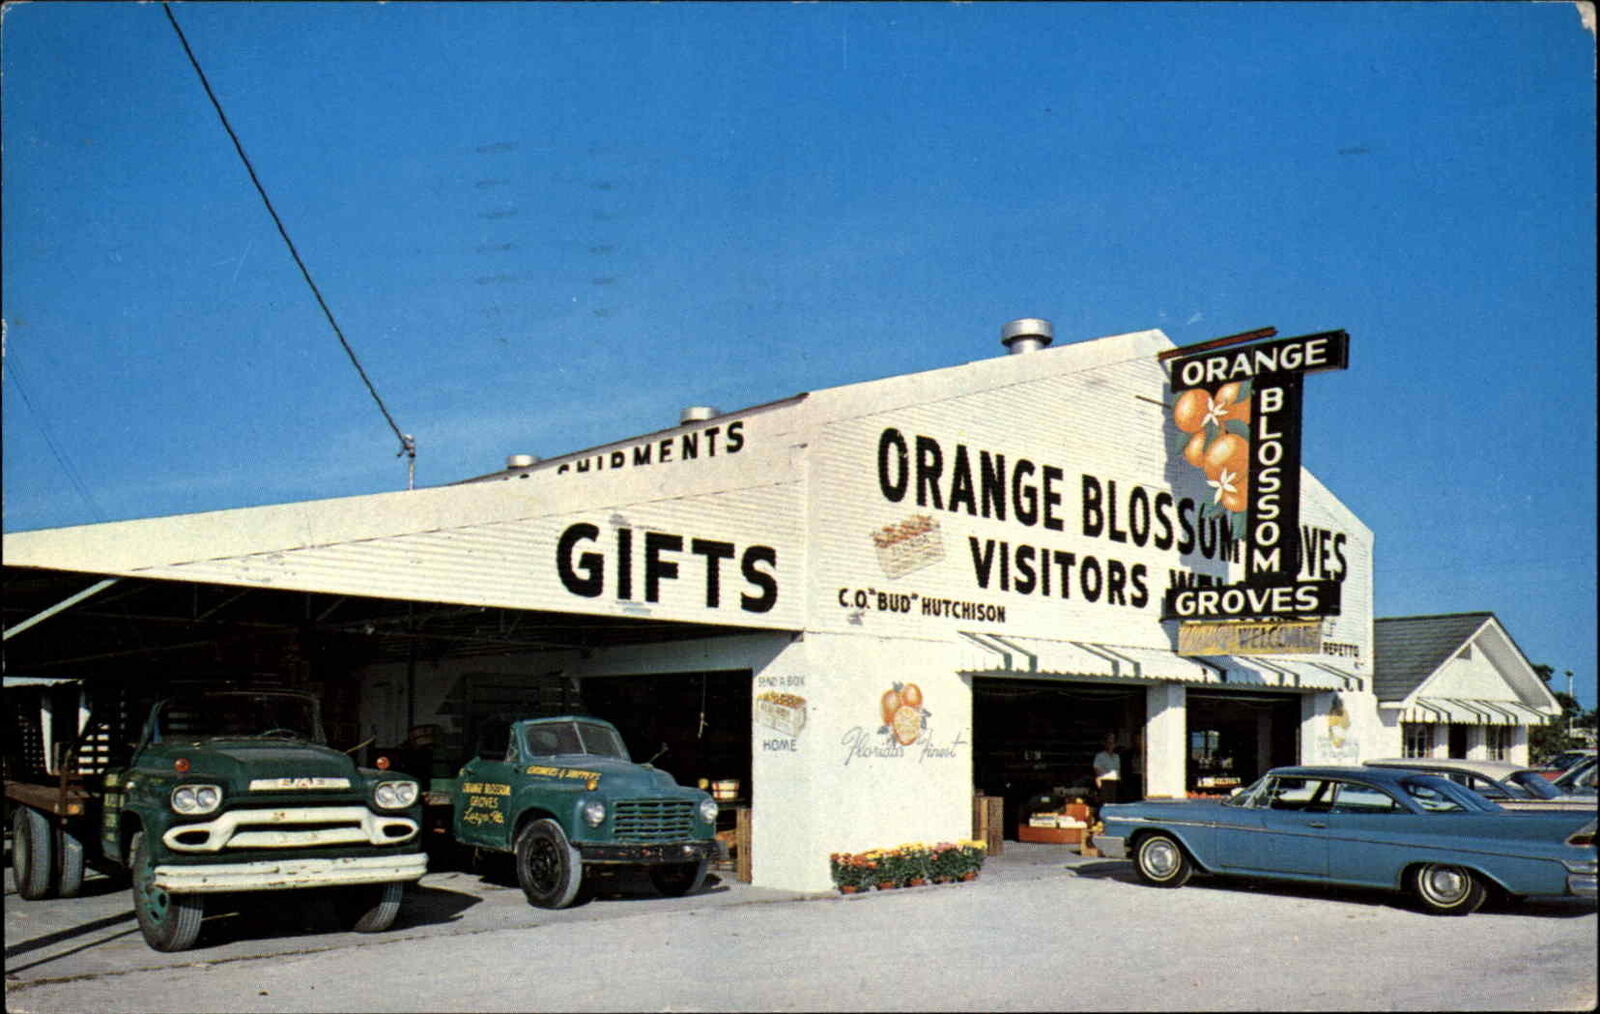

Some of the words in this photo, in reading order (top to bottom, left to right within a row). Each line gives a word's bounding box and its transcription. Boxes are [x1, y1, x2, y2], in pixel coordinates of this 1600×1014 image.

[1182, 338, 1328, 386] ORANGE
[878, 427, 1063, 532] ORANGE
[1252, 387, 1284, 573] BLOSSOM
[556, 522, 778, 613] GIFTS
[969, 536, 1148, 608] VISITORS
[921, 597, 1006, 623] HUTCHISON
[1175, 585, 1319, 615] GROVES
[763, 739, 798, 752] HOME
